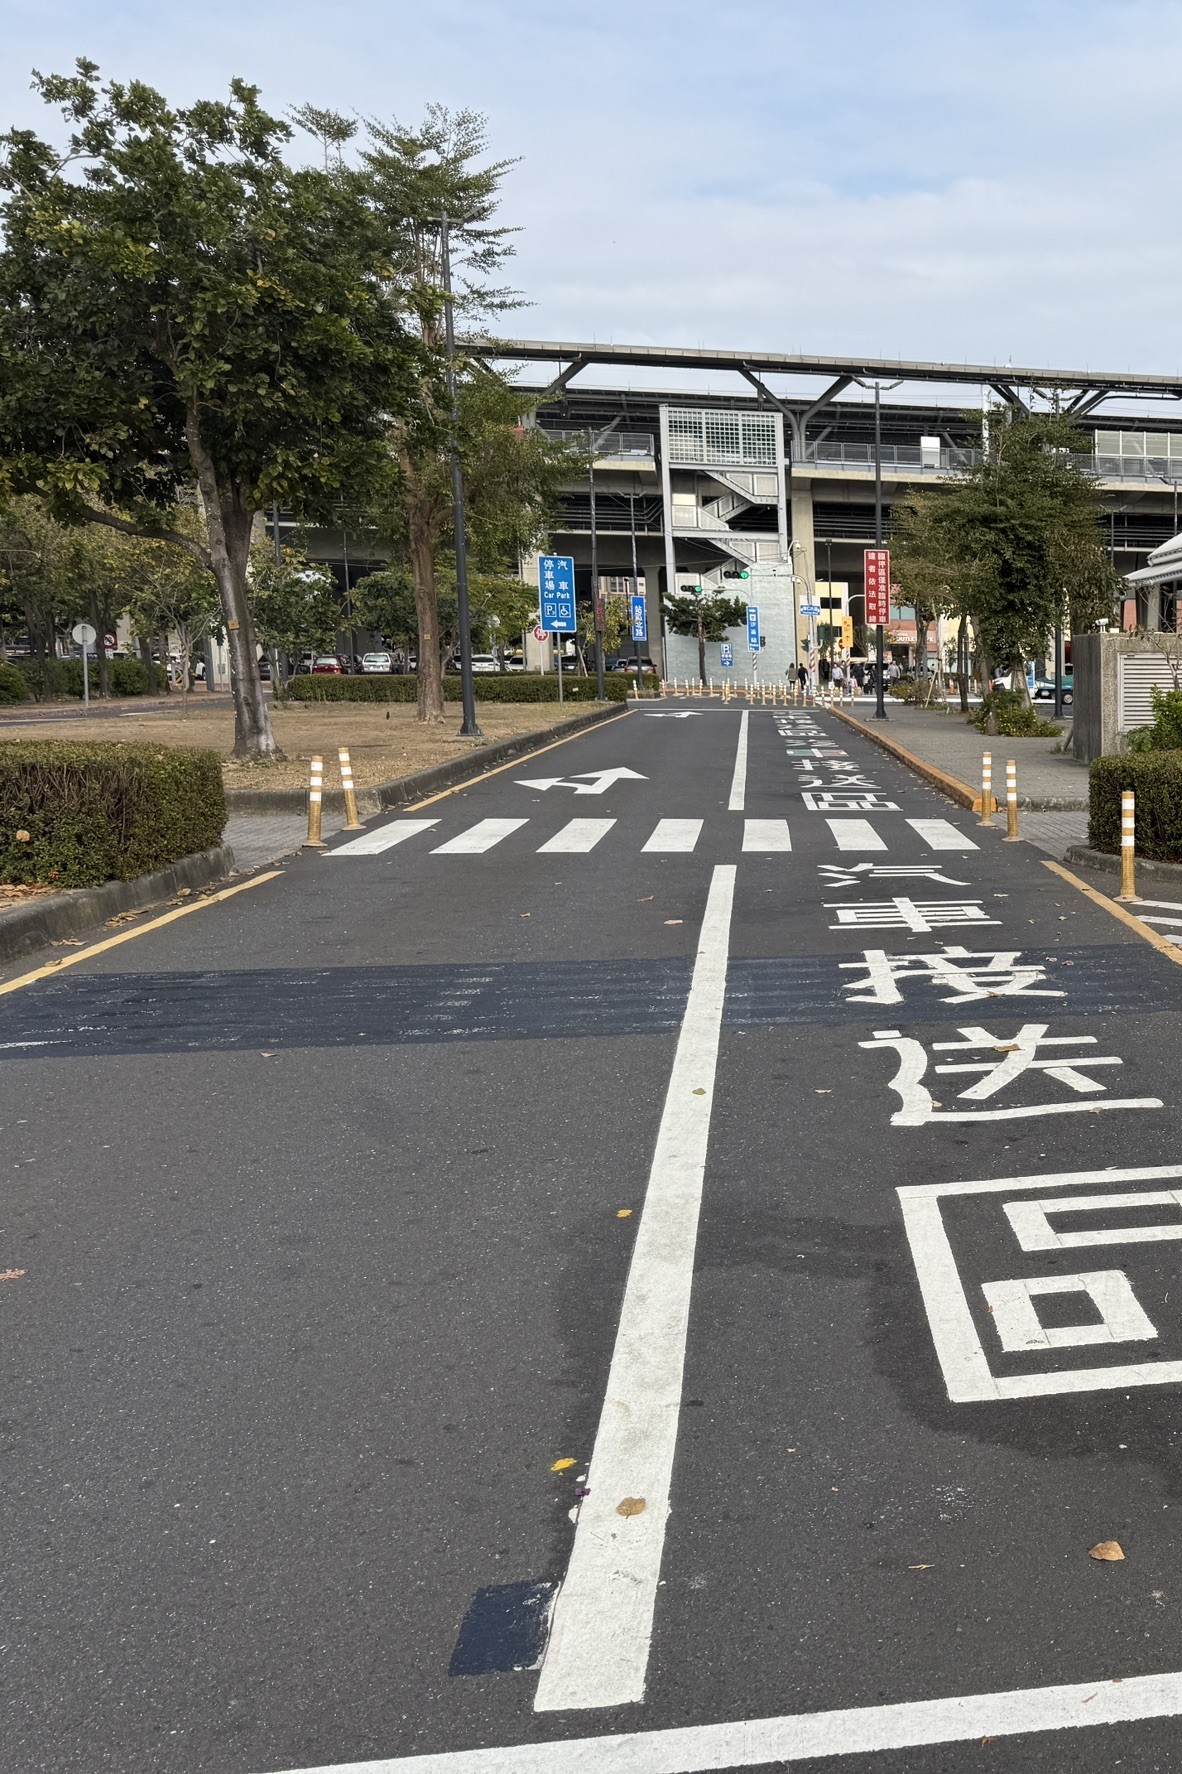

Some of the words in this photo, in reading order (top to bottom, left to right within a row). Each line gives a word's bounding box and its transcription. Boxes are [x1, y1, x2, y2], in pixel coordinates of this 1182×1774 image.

[543, 559, 555, 591] 停車場
[557, 559, 569, 591] 汽車
[868, 552, 877, 623] 違者依法取締
[543, 591, 554, 599] Car
[557, 591, 570, 599] Park
[784, 738, 904, 811] 汽車接送區
